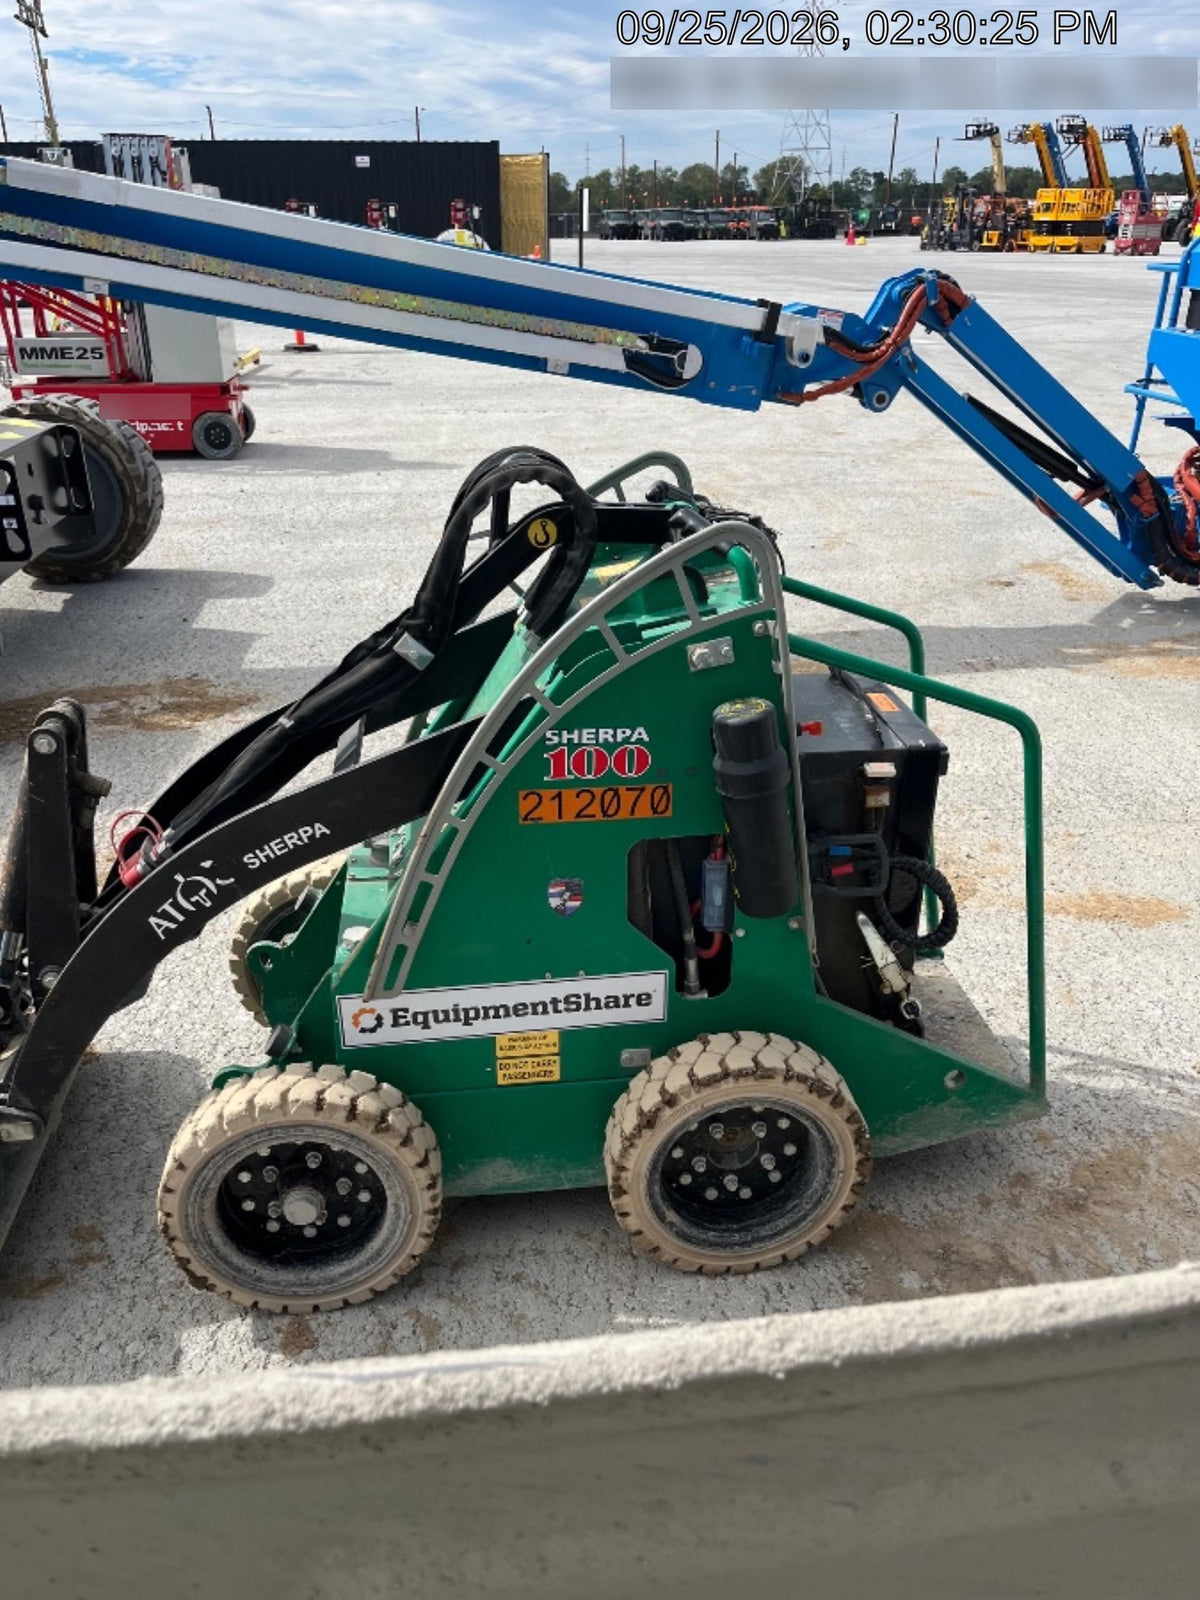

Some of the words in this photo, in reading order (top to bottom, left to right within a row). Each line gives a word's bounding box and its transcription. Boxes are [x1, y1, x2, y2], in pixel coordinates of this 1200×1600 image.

[19, 346, 104, 360] MME25
[545, 727, 650, 745] SHERPA
[543, 744, 651, 781] 100
[521, 783, 671, 822] 212070
[242, 822, 331, 870] SHERPA
[389, 988, 654, 1030] EquipmentShare
